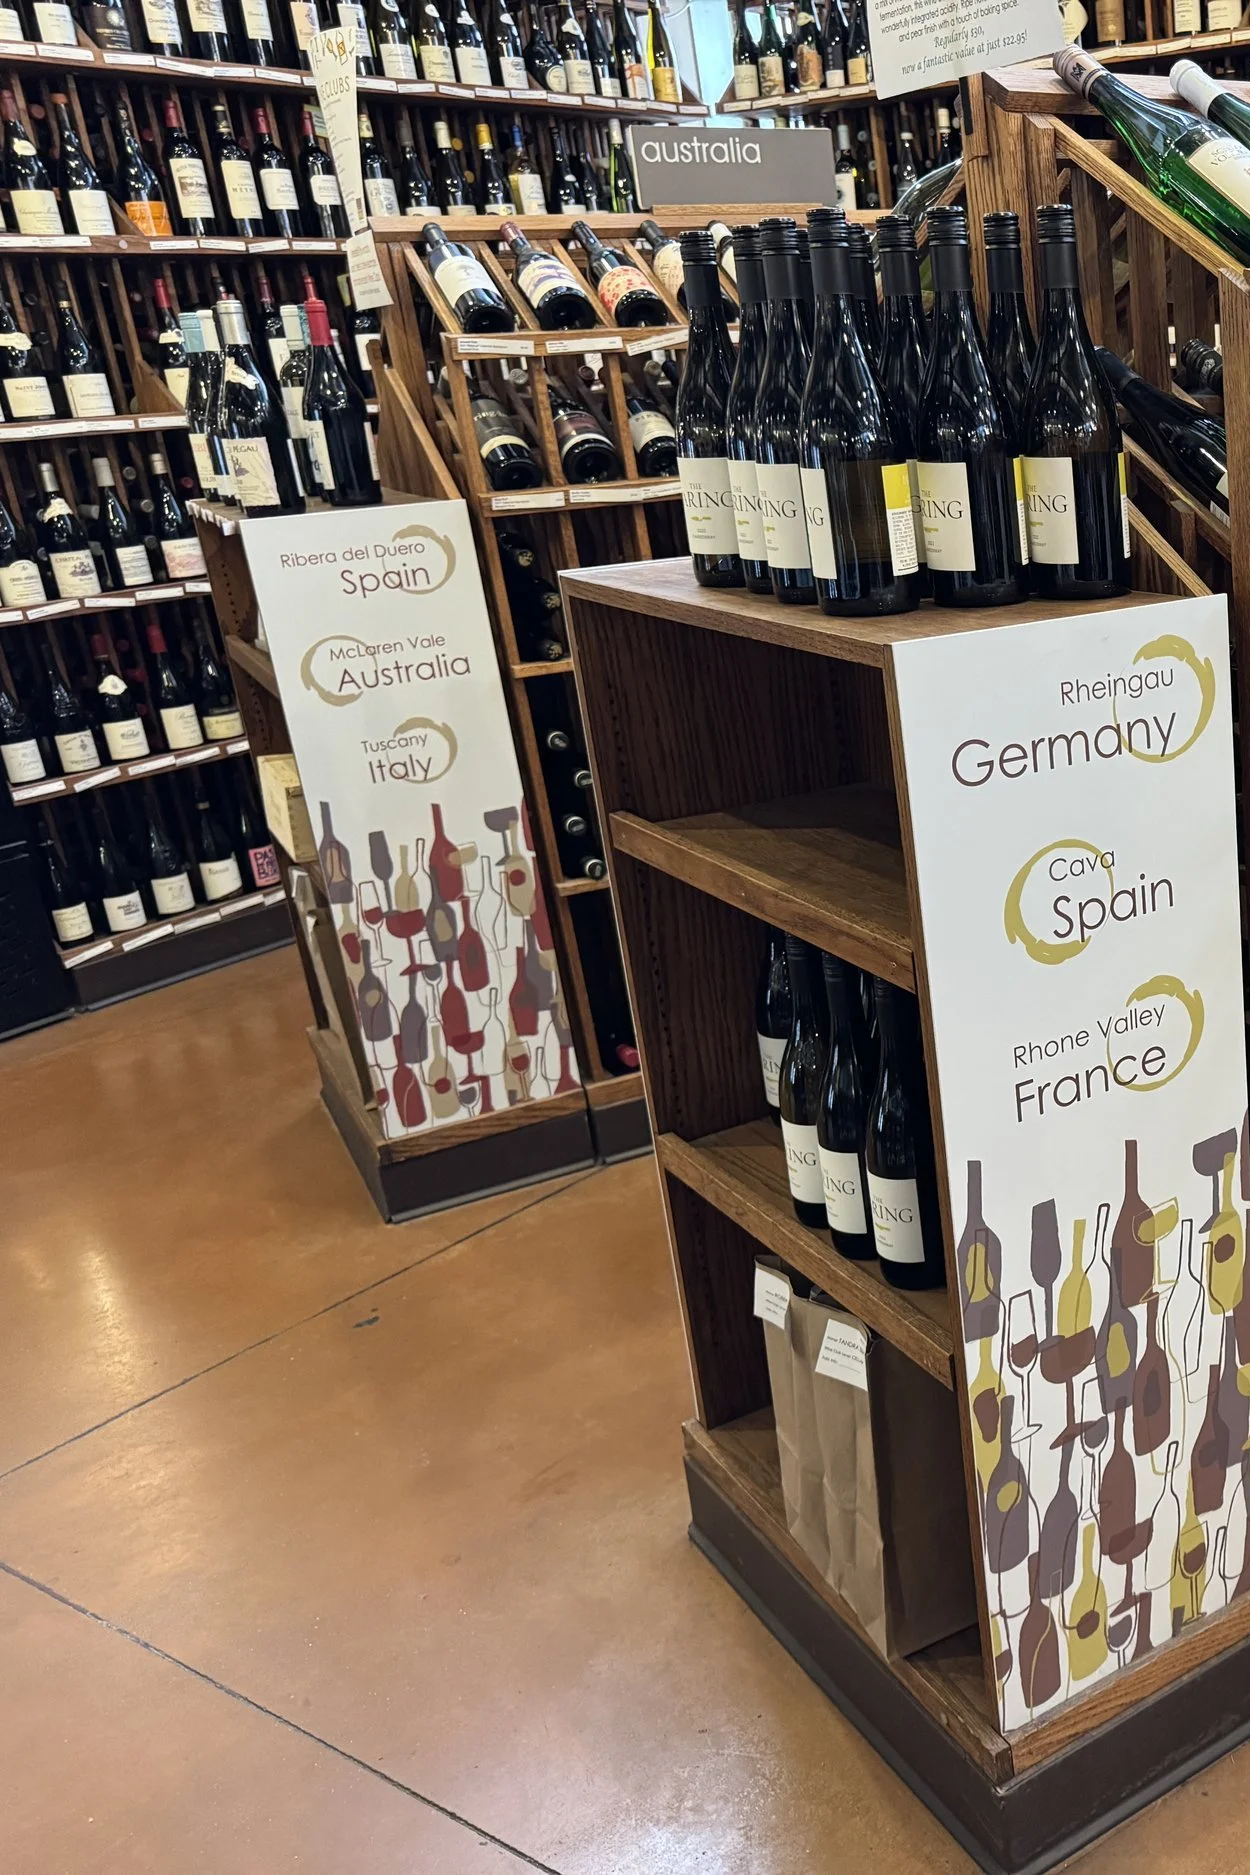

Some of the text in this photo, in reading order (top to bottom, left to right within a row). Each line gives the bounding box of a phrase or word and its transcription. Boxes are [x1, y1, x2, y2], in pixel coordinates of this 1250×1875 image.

[879, 5, 913, 21] fermentation,
[881, 17, 911, 34] wonderfully
[910, 10, 939, 27] integrated
[939, 2, 959, 16] acidity.
[898, 32, 910, 43] and
[911, 28, 924, 41] pear
[924, 22, 939, 36] finish
[938, 18, 950, 30] with
[955, 12, 973, 26] touch
[980, 3, 1000, 19] baking
[1000, 0, 1020, 14] spice.
[901, 64, 916, 75] now
[922, 51, 954, 74] fantastic
[955, 40, 975, 60] value
[977, 42, 985, 53] at
[986, 37, 1001, 56] just
[1002, 28, 1028, 47] $22.95!
[933, 24, 985, 50] Regularly $30,
[641, 137, 762, 163] australia
[280, 542, 425, 568] Ribera del Duero
[341, 563, 430, 598] Spain
[329, 634, 446, 662] McLaren Vale
[338, 654, 471, 692] Australia
[1060, 668, 1175, 706] Rheingau
[361, 733, 428, 754] Tuscany
[952, 712, 1176, 787] Germany
[368, 754, 433, 784] Italy
[1048, 850, 1115, 881] Cava
[1053, 873, 1174, 942] Spain
[1013, 1004, 1166, 1068] Rhone Valley
[1014, 1045, 1166, 1123] France
[788, 1147, 817, 1167] ING
[824, 1178, 855, 1196] ING
